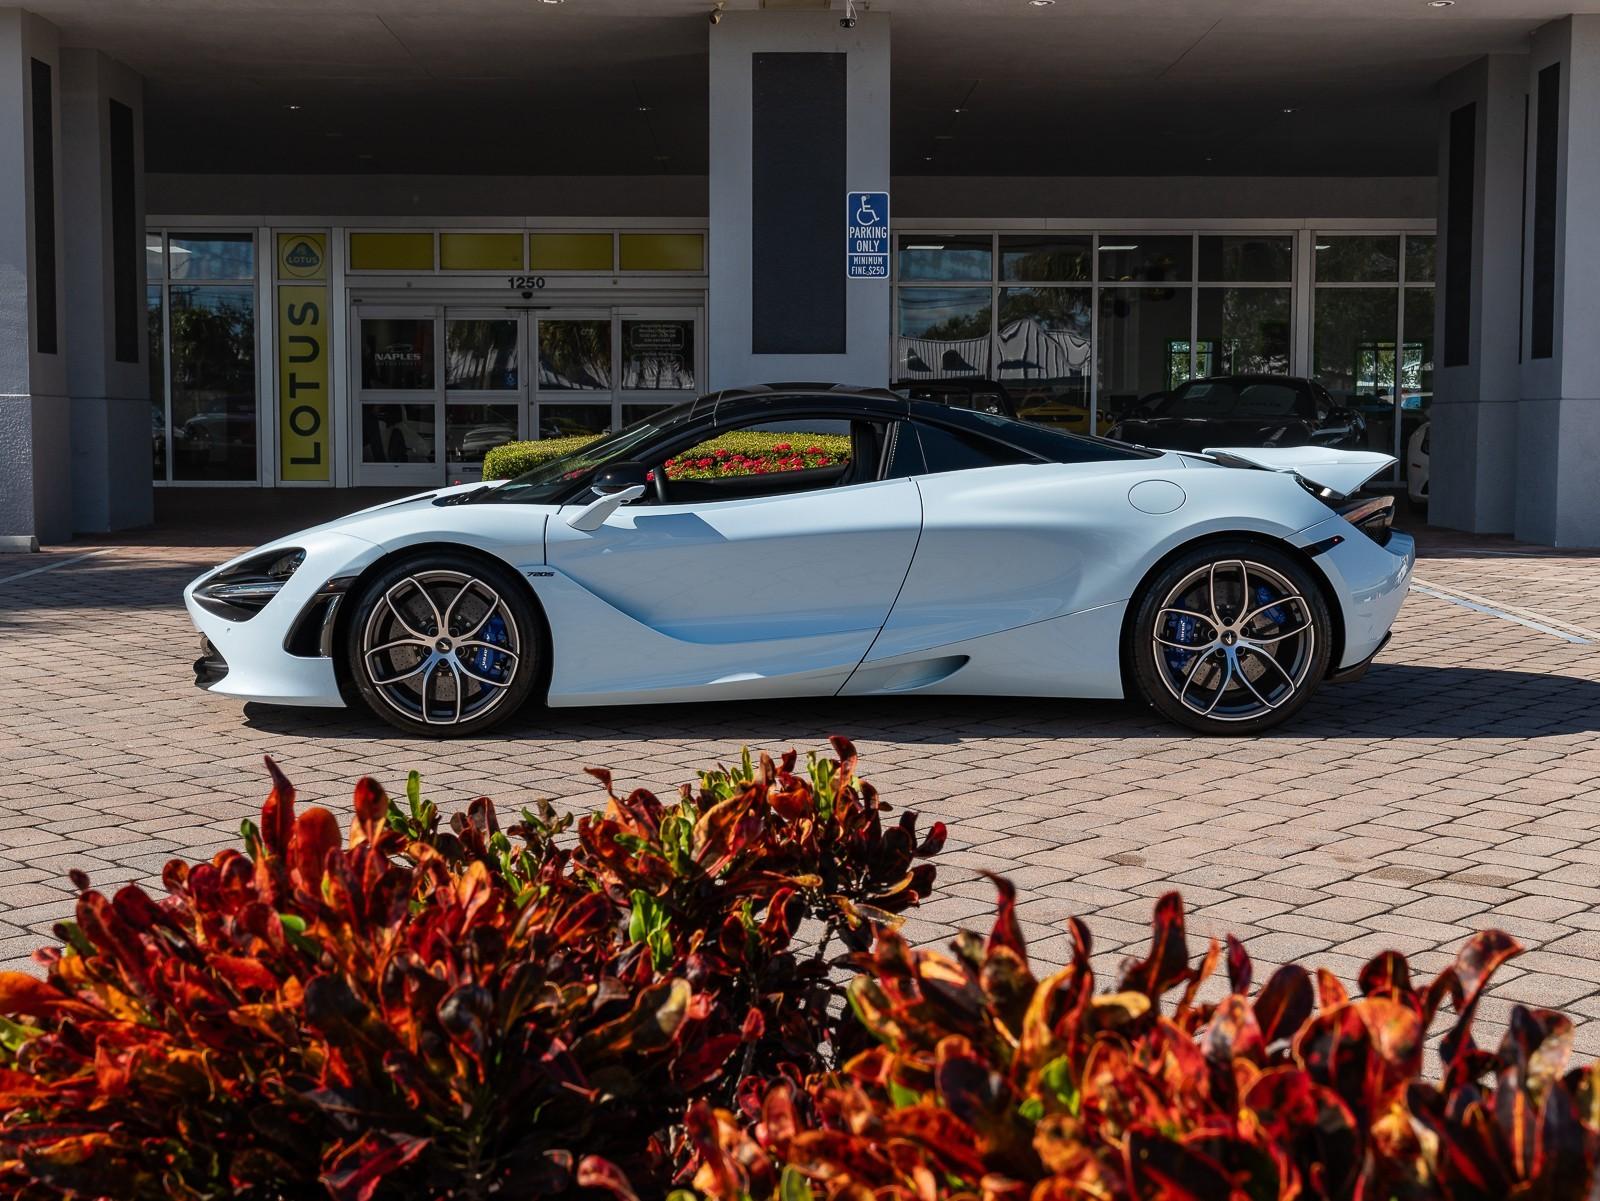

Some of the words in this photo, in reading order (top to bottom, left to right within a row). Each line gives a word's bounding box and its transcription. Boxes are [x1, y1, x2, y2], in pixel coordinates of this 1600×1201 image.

[849, 226, 887, 239] PARKING
[856, 240, 879, 252] ONLY
[288, 256, 318, 264] LOTUS
[853, 256, 883, 265] MINIMUM
[851, 266, 866, 275] FINE
[868, 265, 885, 275] $250
[508, 277, 545, 289] 1250
[374, 353, 422, 361] NAPLES
[287, 302, 321, 465] LOTUS
